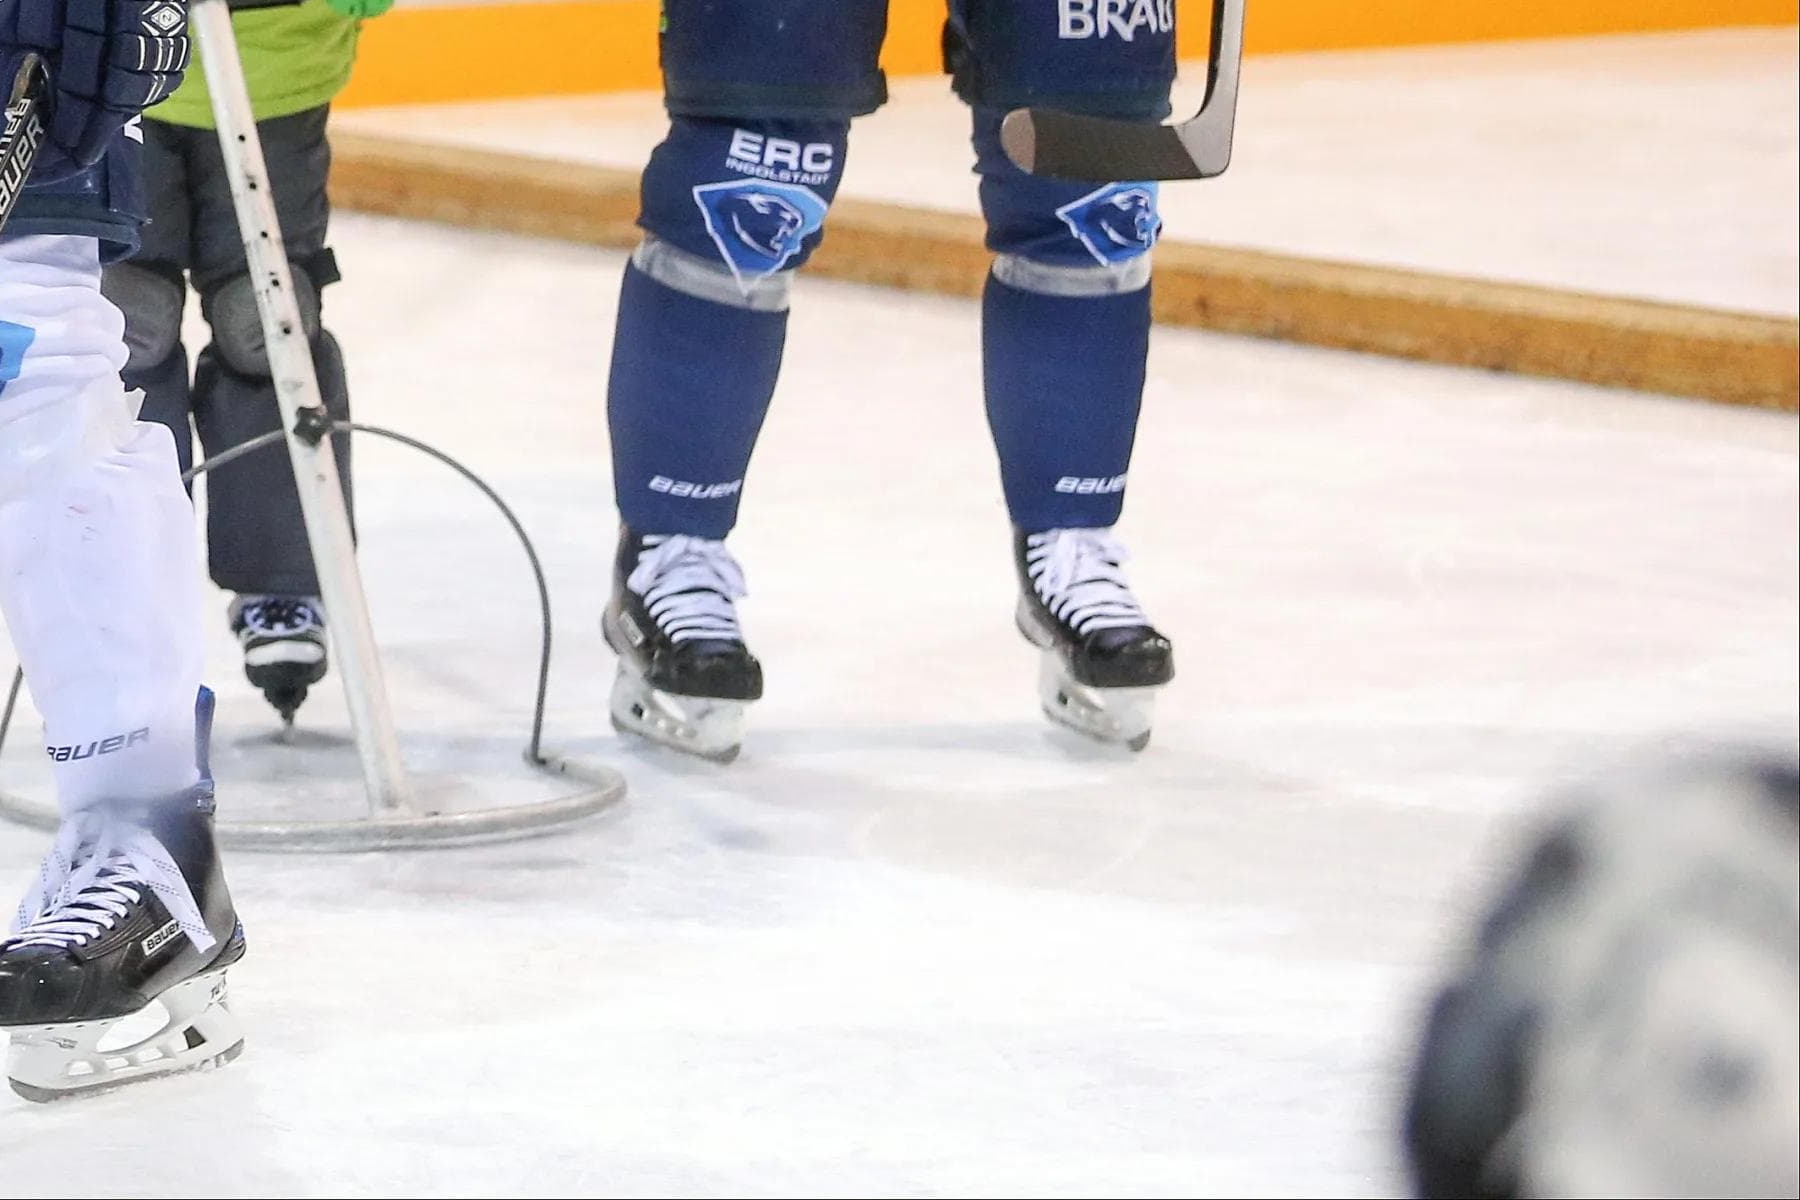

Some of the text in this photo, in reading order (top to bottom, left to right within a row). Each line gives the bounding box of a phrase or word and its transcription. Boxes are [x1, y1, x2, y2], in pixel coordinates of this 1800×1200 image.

[729, 128, 834, 173] ERC
[725, 157, 830, 186] INGOLSTADT
[649, 474, 742, 499] BAUER
